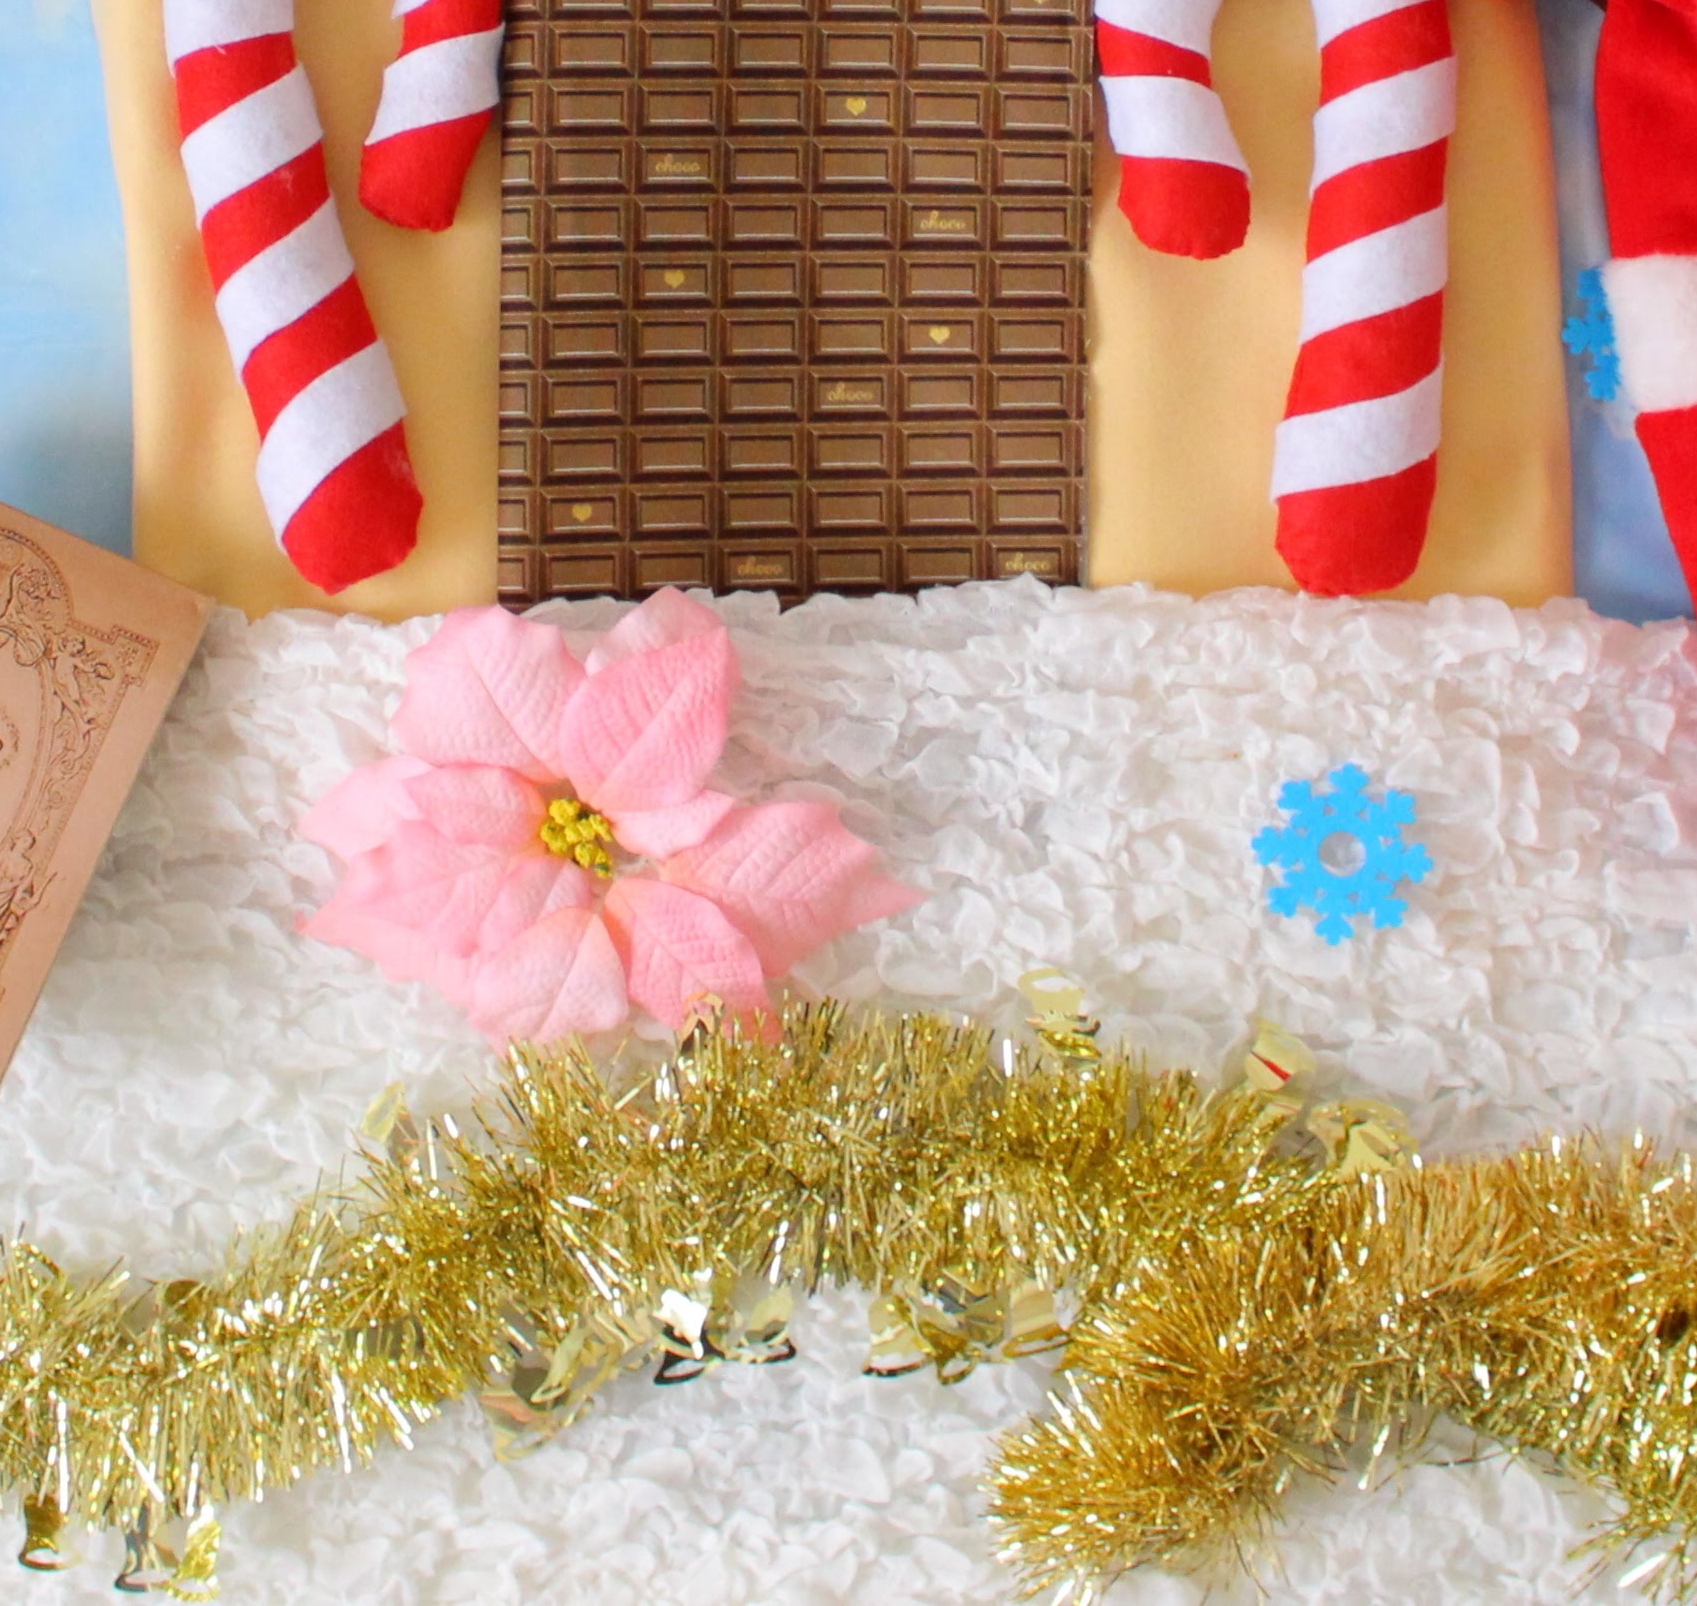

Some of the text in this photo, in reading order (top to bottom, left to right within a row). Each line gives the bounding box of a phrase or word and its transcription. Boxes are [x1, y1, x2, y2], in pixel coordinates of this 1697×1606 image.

[655, 153, 701, 172] choco
[920, 210, 965, 230] choco
[1005, 551, 1051, 570] choco
